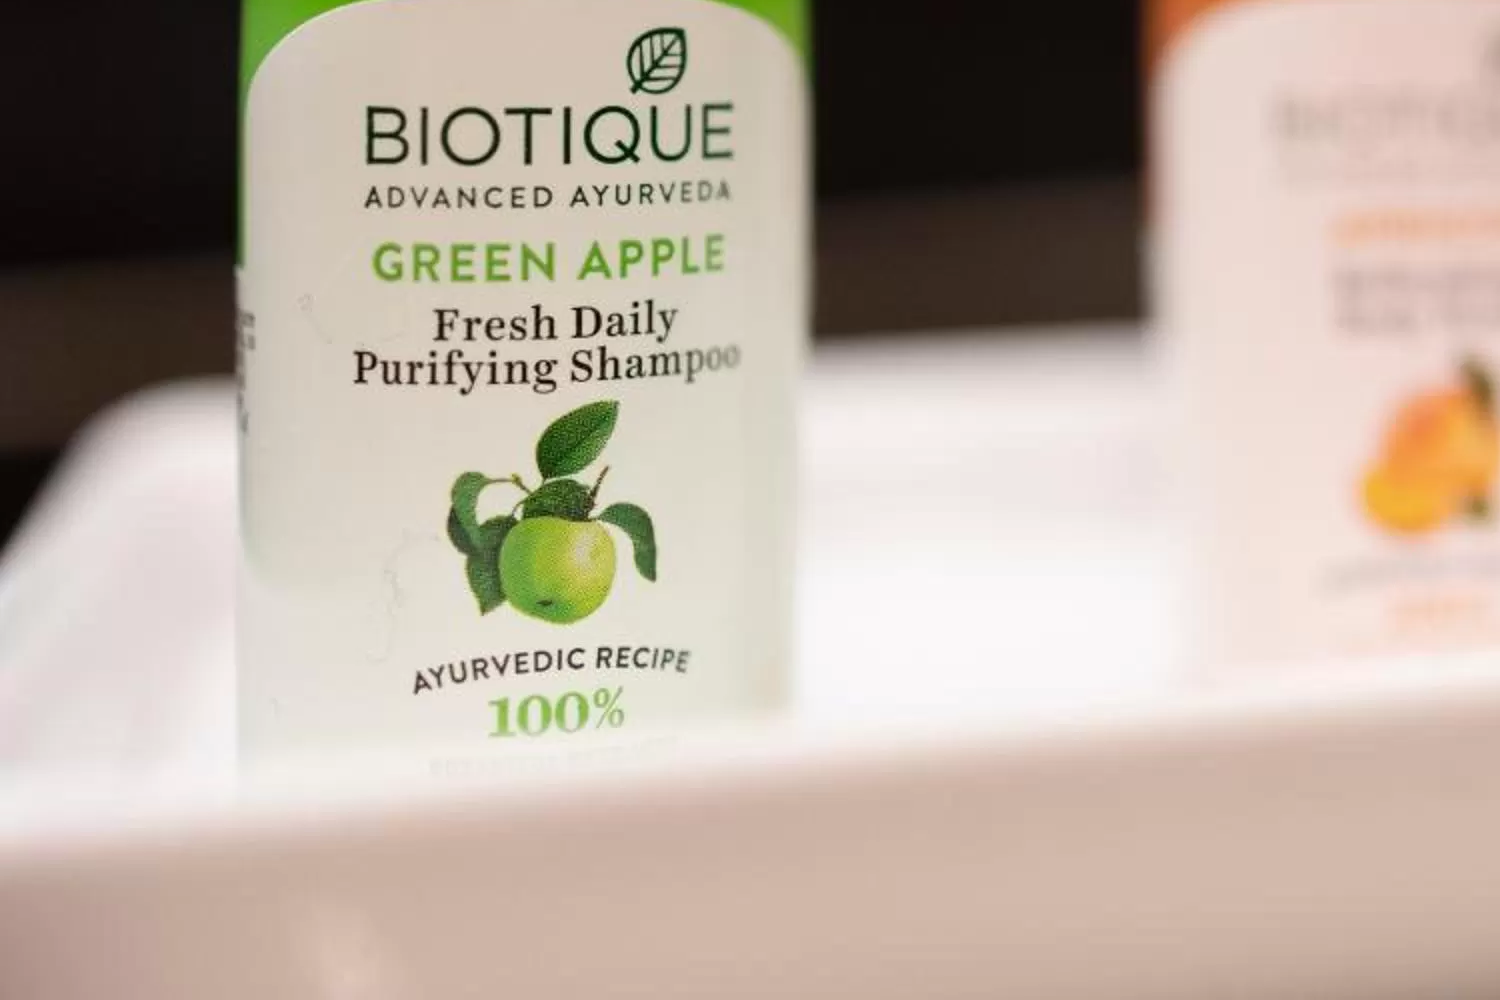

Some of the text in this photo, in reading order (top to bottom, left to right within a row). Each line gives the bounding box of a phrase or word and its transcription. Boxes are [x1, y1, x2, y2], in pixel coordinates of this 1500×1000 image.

[366, 103, 734, 166] BIOTIQUE
[364, 179, 731, 209] ADVANCED AYURVEDA
[372, 234, 725, 283] GREEN APPLE
[433, 299, 680, 343] Fresh Daily
[353, 344, 741, 396] Purifying Shampoo
[413, 646, 691, 695] AYURVEDIC RECIPE
[487, 686, 626, 738] 100%
